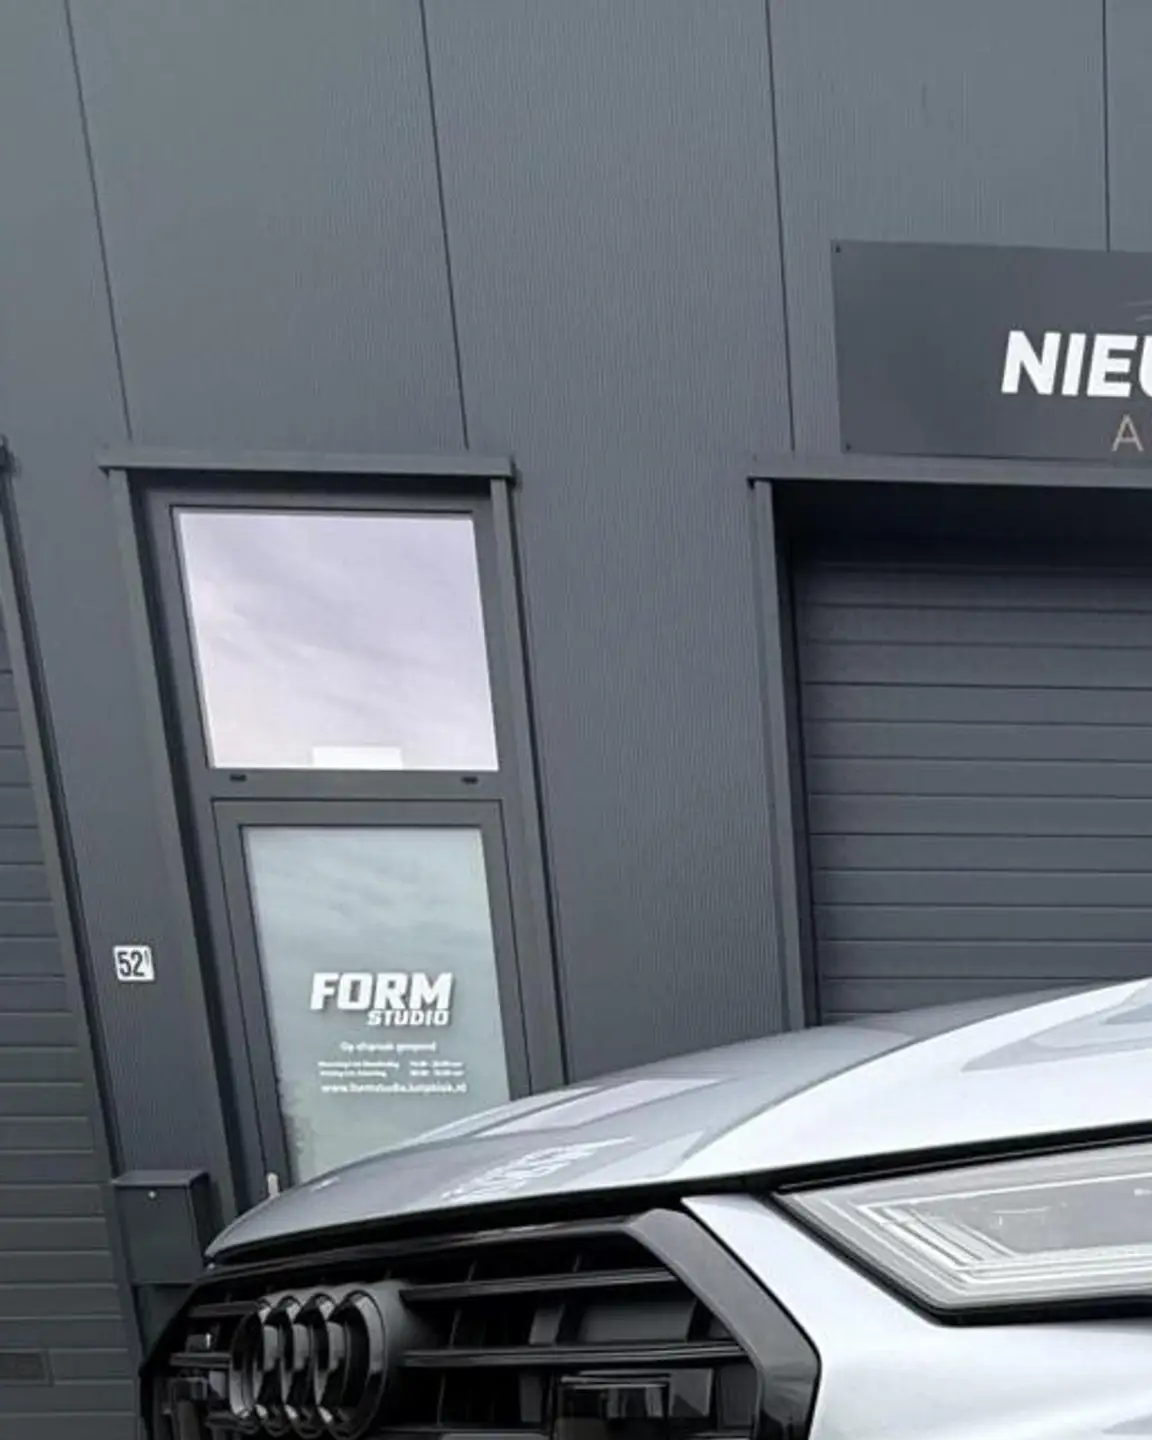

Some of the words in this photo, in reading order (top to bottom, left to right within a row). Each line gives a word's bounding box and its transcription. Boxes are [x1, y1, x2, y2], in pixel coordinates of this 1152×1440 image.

[117, 951, 145, 977] 52
[310, 972, 453, 1010] FORM
[367, 1010, 450, 1026] STUDIO
